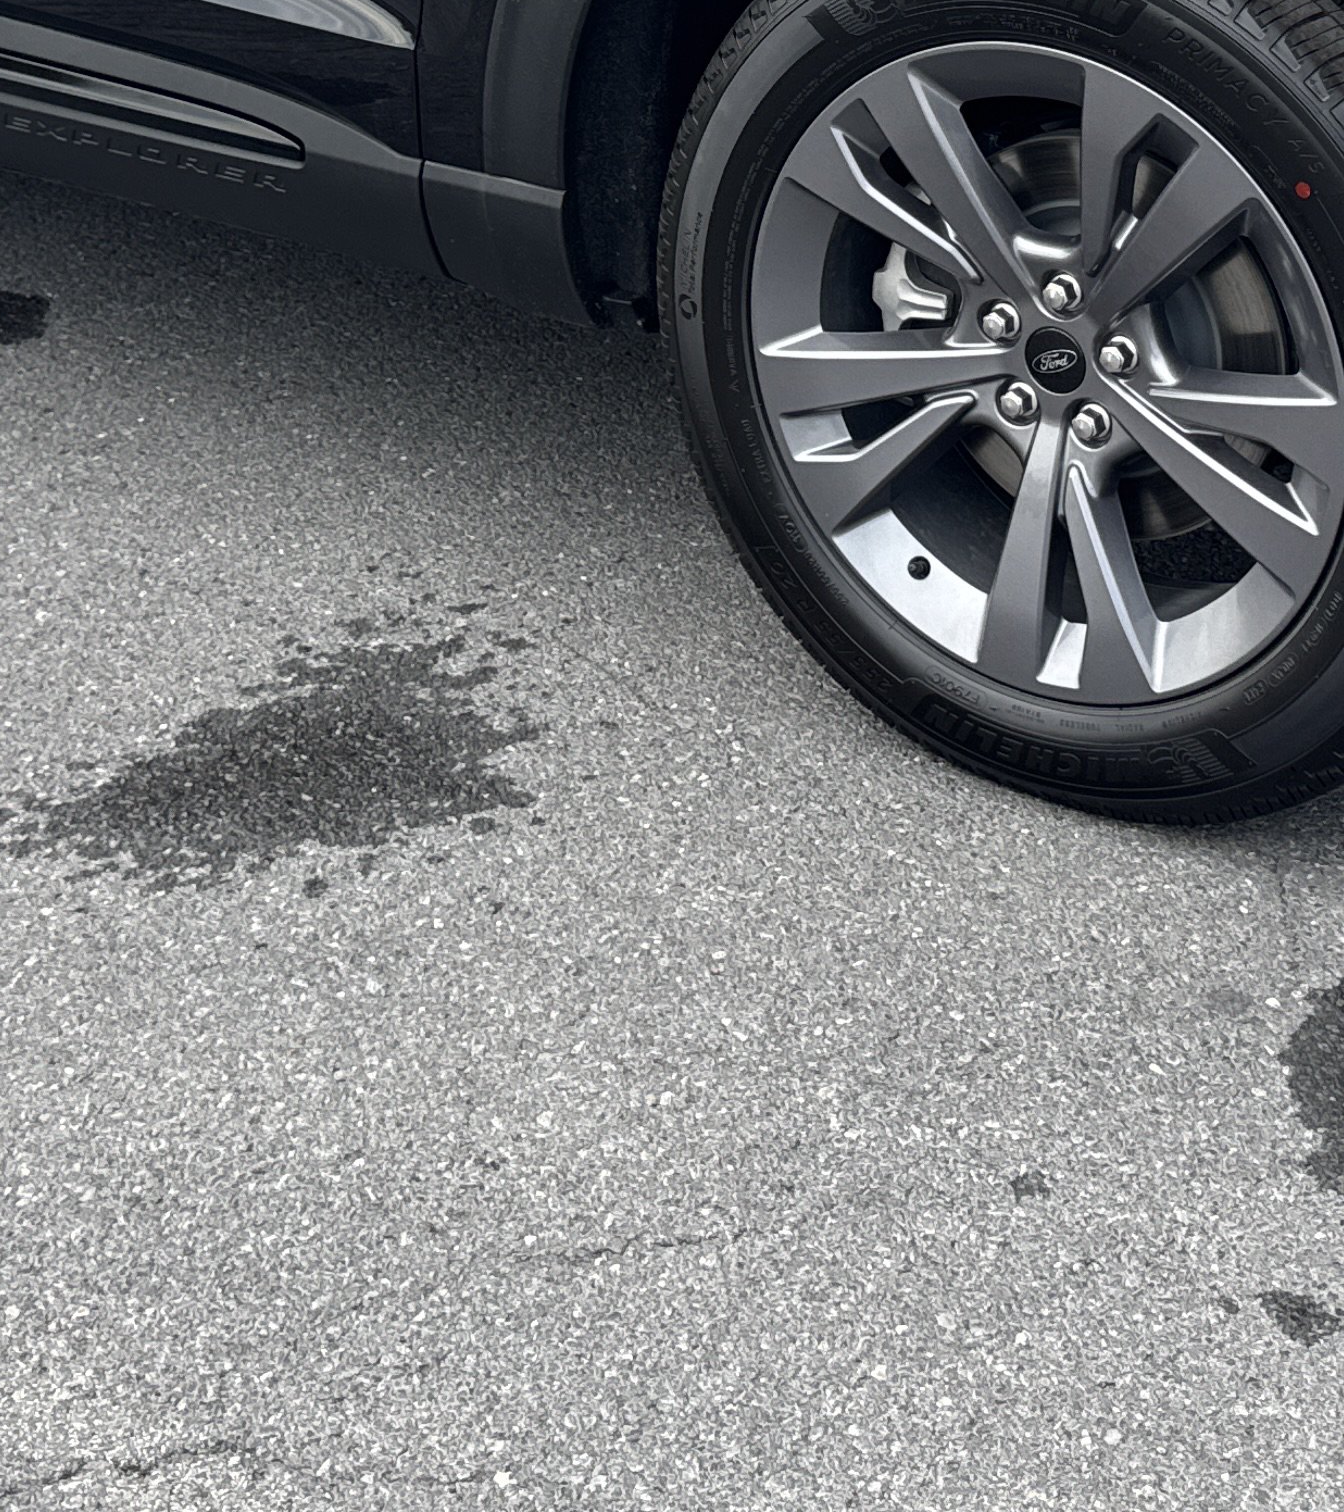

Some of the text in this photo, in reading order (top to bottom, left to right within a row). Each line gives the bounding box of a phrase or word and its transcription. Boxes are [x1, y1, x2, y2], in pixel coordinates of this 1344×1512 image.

[1161, 26, 1290, 128] PRIMACY
[5, 116, 286, 193] EXPLORER
[1040, 353, 1069, 370] Ford
[923, 702, 1140, 782] MICHELIN
